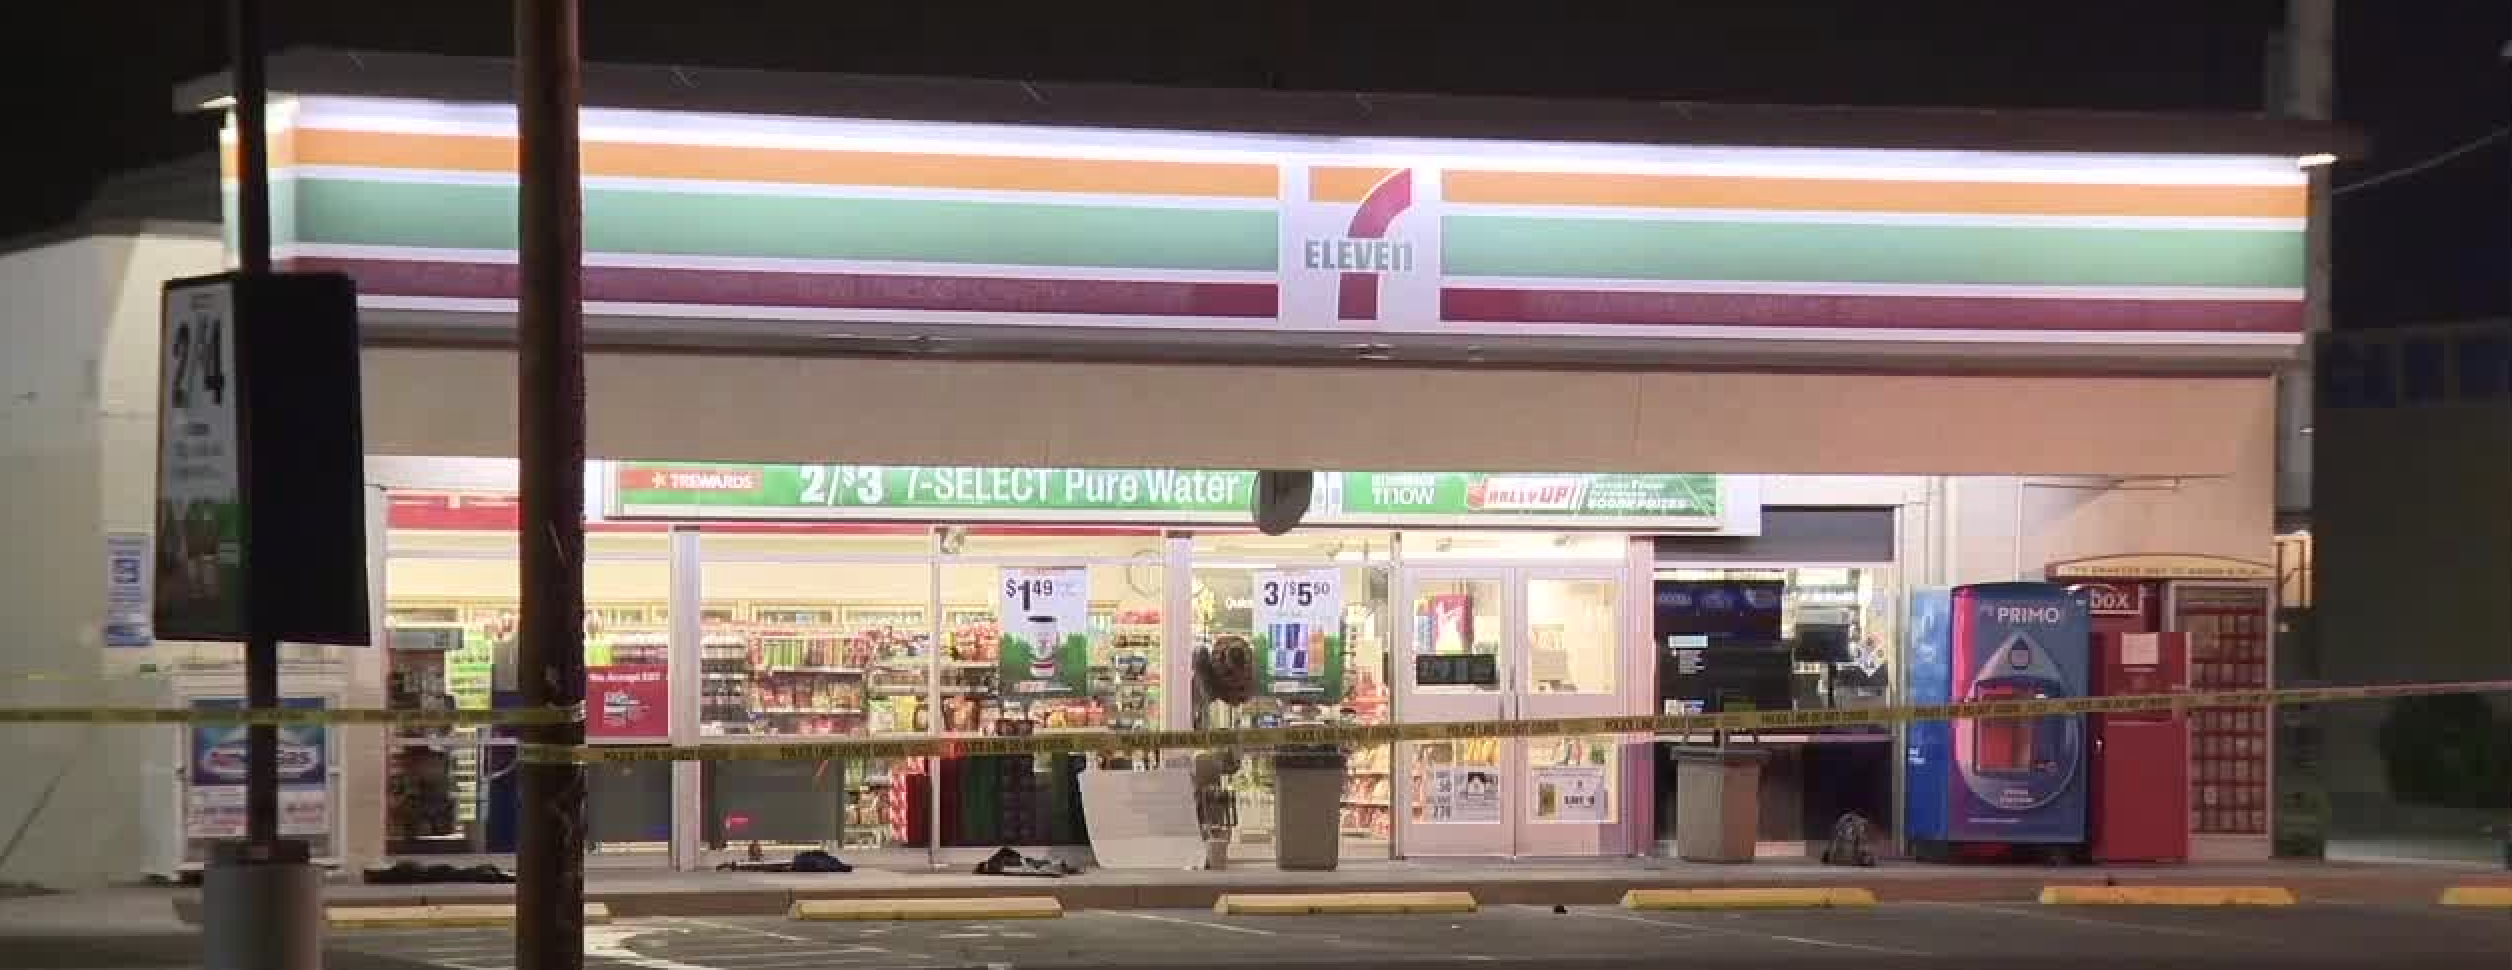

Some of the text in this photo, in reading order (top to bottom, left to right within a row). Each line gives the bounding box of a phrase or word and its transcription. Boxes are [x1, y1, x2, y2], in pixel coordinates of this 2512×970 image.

[1308, 167, 1413, 320] 7
[799, 466, 1240, 505] 2/$3 7-SELECT Pure Water
[1997, 607, 2060, 623] PRIMO
